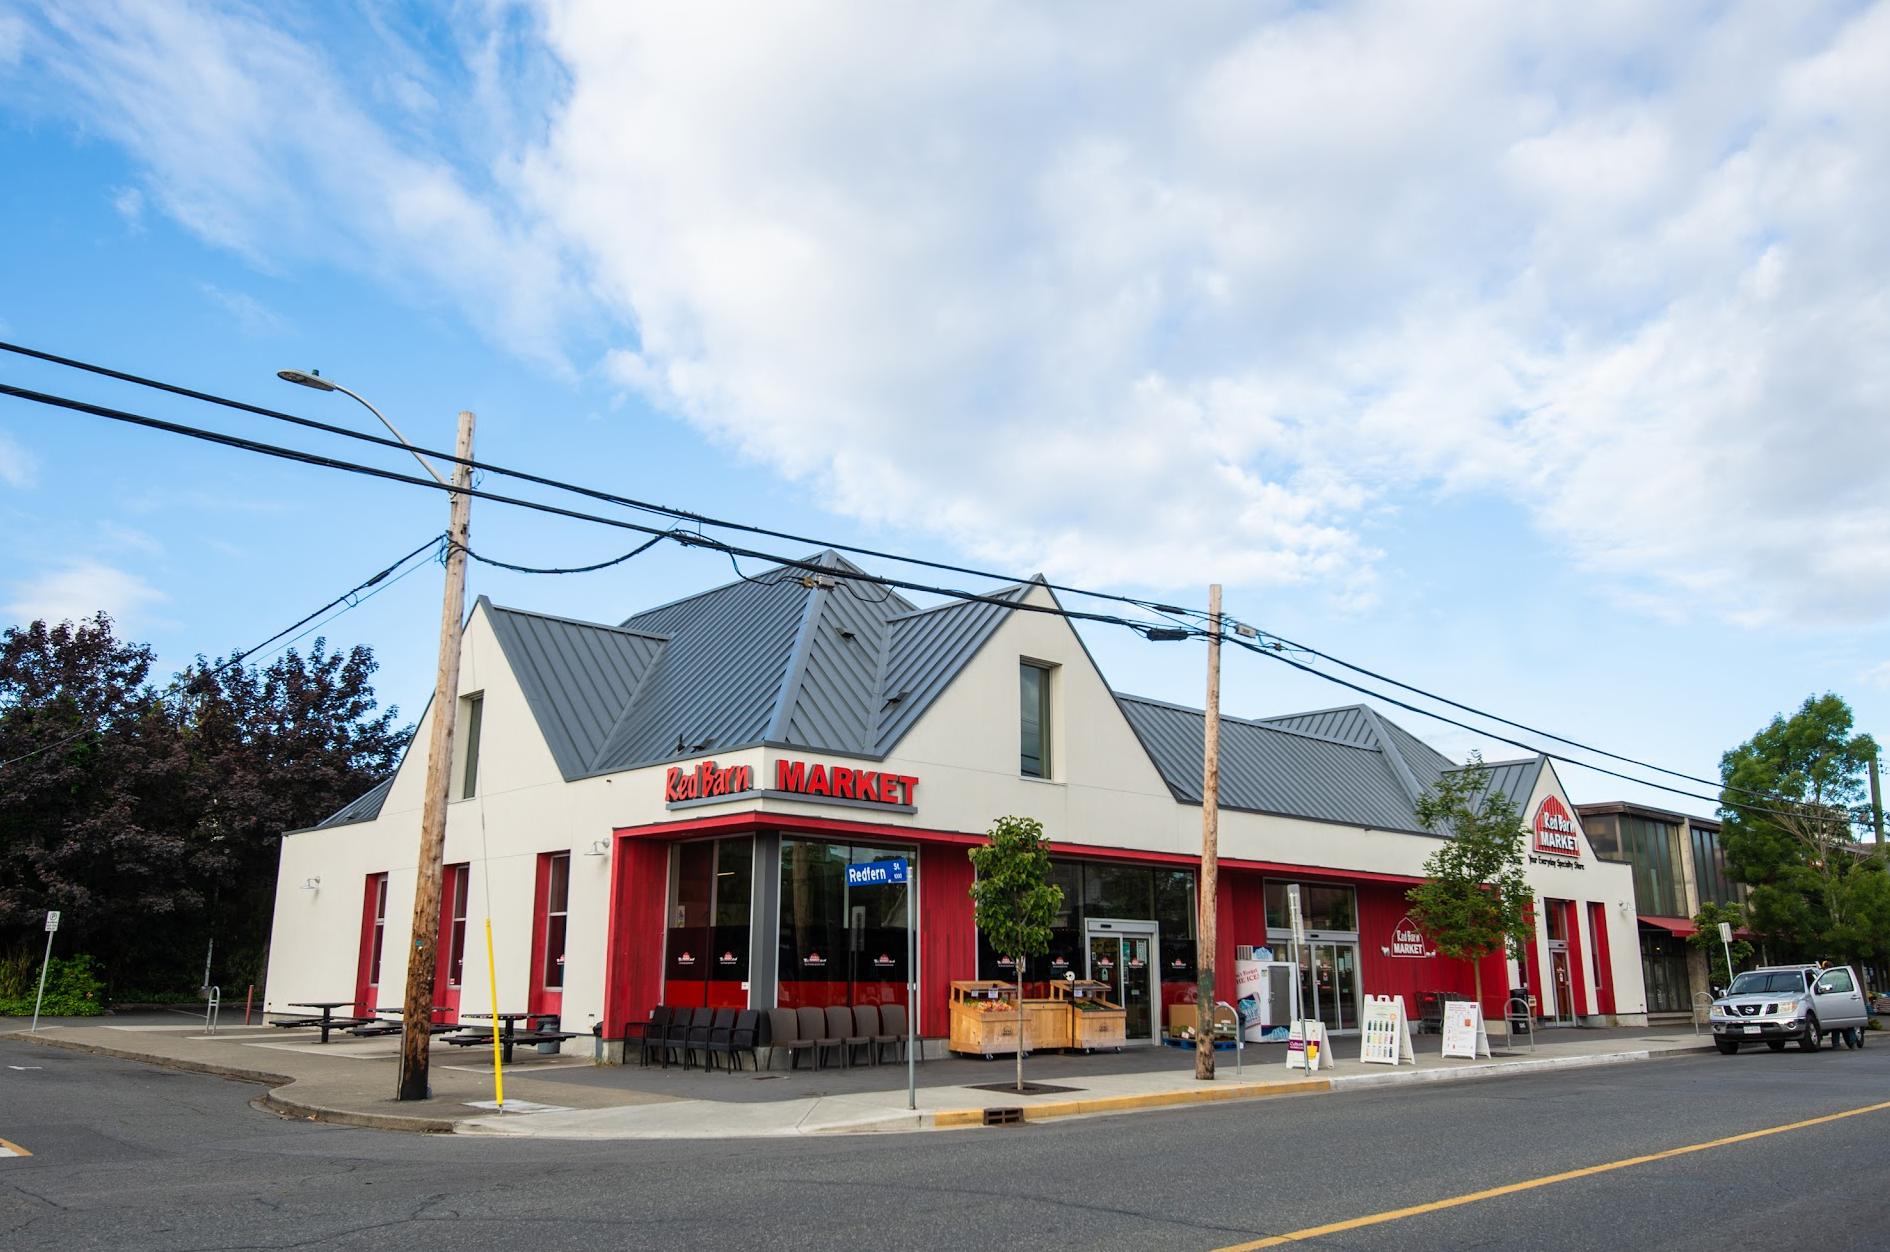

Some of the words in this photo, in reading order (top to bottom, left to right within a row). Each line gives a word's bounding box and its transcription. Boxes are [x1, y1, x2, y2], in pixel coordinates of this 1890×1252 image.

[665, 765, 700, 802] Red
[702, 760, 752, 797] Barn
[775, 759, 919, 805] MARKET
[1541, 831, 1579, 851] MARKET
[848, 867, 887, 883] Redfern
[1393, 943, 1423, 955] MARKET
